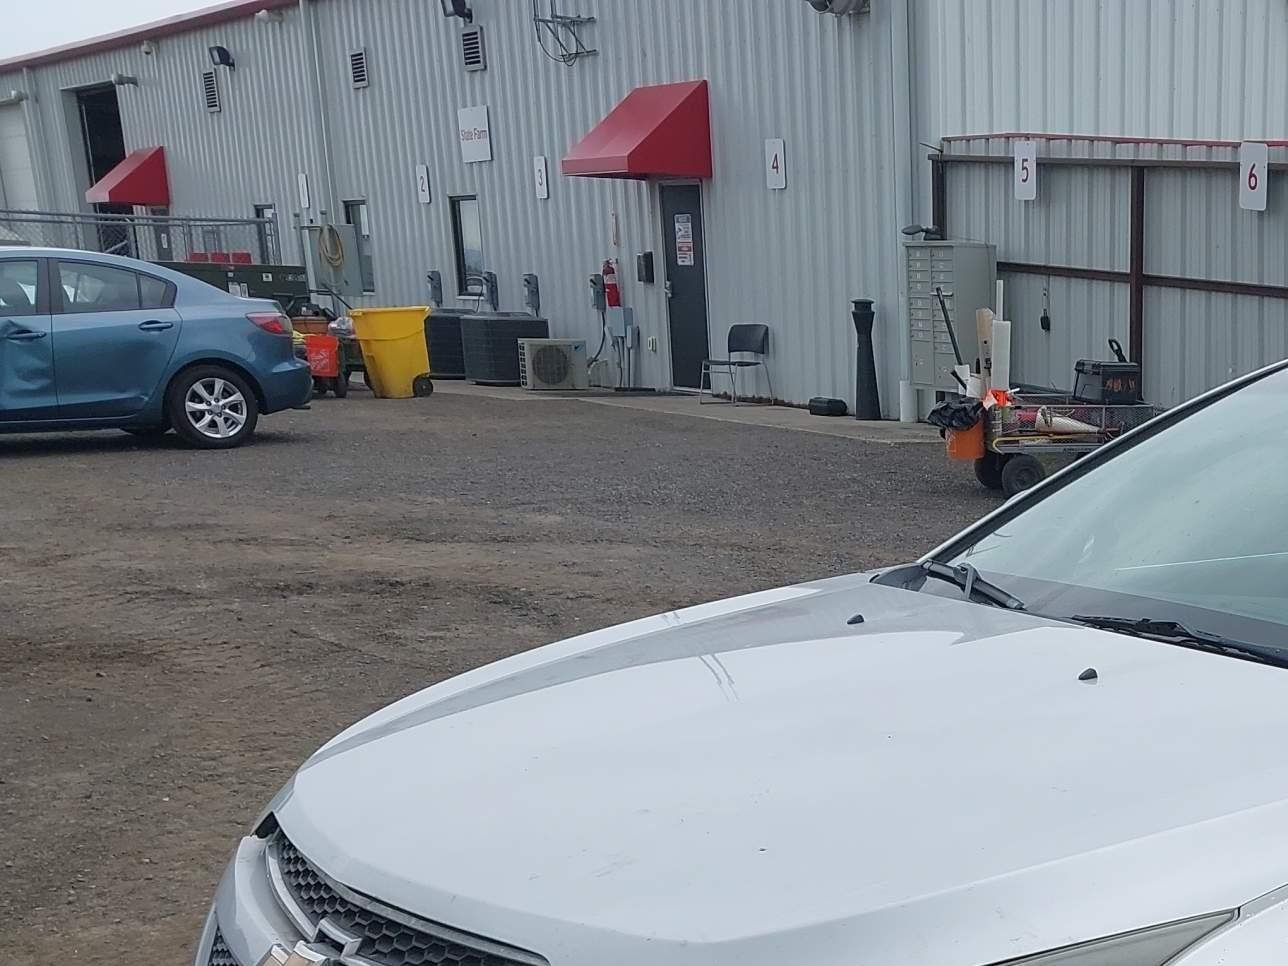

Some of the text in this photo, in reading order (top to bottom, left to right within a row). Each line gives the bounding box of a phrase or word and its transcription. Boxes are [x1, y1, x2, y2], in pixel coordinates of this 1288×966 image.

[771, 153, 779, 174] 4
[1021, 158, 1029, 183] 5
[419, 175, 425, 193] 2
[537, 169, 544, 186] 3
[1248, 162, 1258, 190] 6
